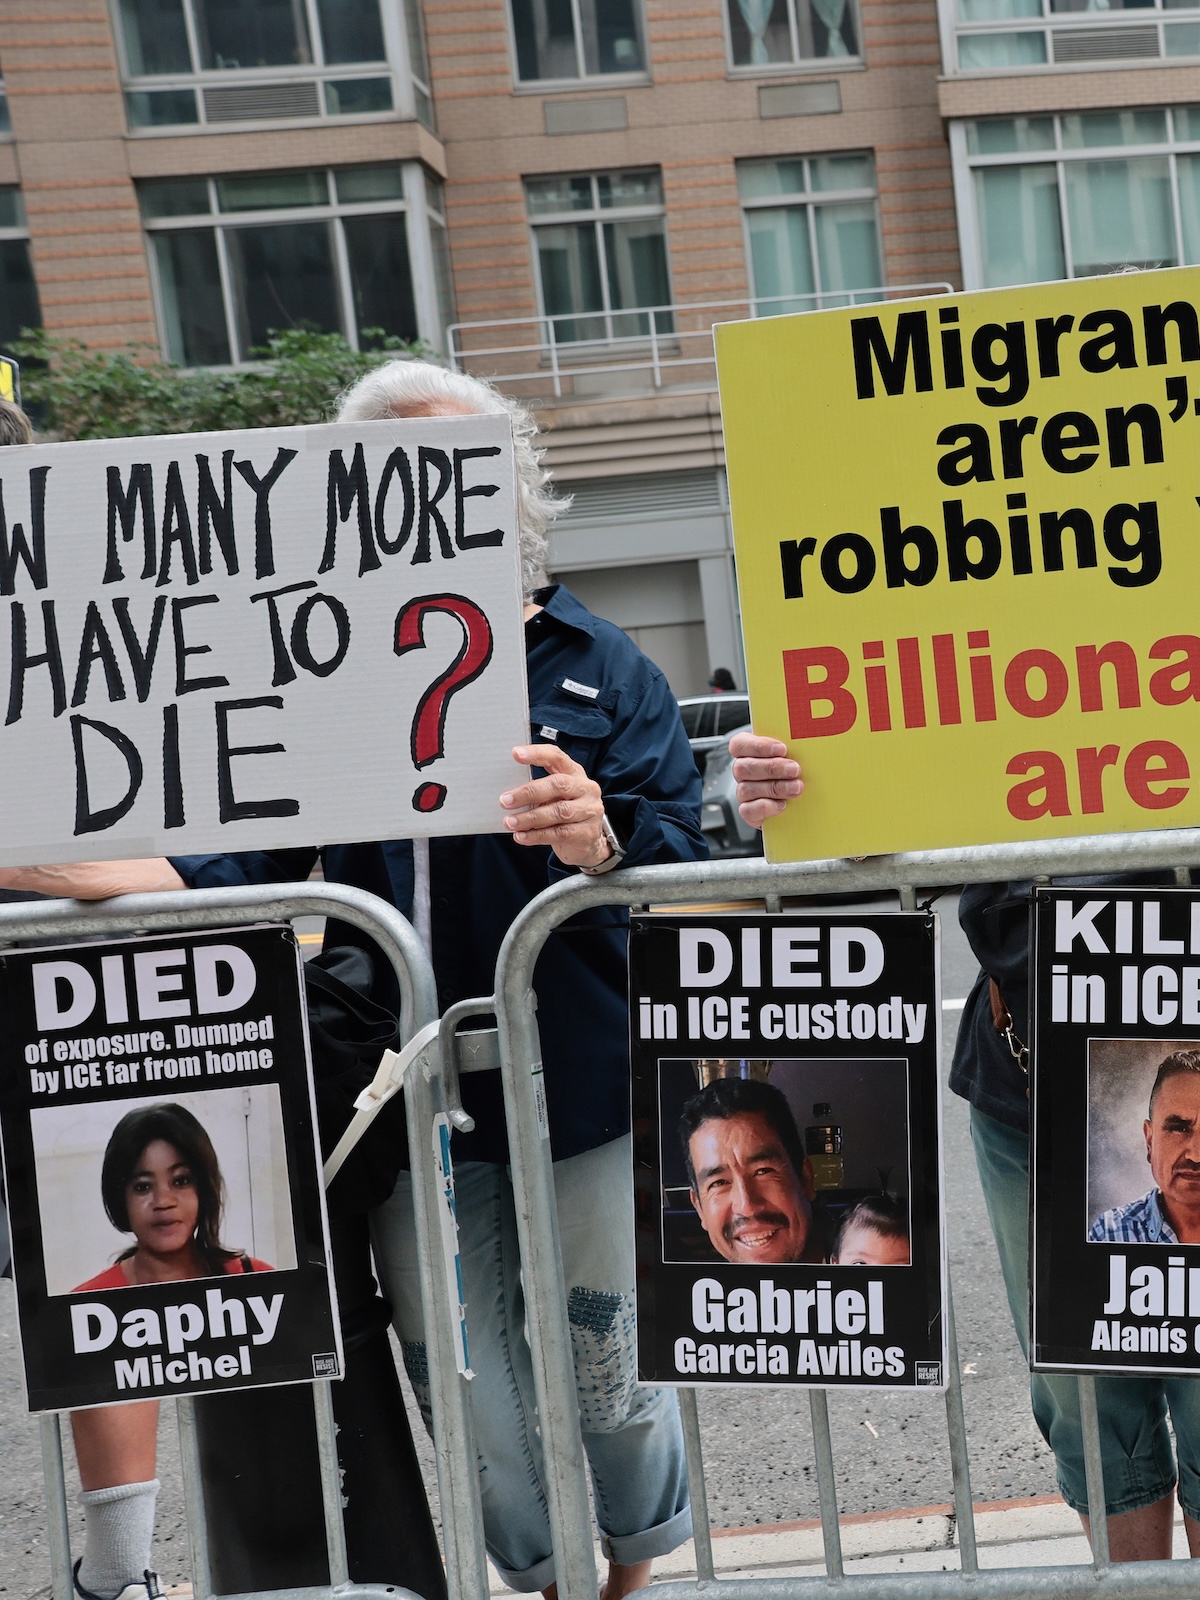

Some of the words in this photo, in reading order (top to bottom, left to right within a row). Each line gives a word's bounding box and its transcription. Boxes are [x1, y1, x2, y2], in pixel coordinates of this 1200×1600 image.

[103, 447, 298, 587] MANY
[318, 443, 503, 577] MORE
[780, 493, 1161, 599] robbing
[5, 595, 229, 725] HAVE
[250, 580, 350, 687] TO
[70, 696, 299, 835] DIE
[394, 593, 493, 812] ?
[680, 927, 884, 987] DIED
[32, 945, 256, 1031] DIED
[1052, 965, 1105, 1023] in
[25, 1039, 48, 1064] of
[54, 1031, 171, 1061] exposure.
[175, 1016, 274, 1048] Dumped
[640, 997, 677, 1039] in
[688, 996, 750, 1039] ICE
[760, 997, 927, 1043] custody
[30, 1069, 59, 1094] by
[64, 1062, 102, 1089] ICE
[105, 1061, 139, 1084] far
[144, 1056, 201, 1080] from
[205, 1049, 273, 1074] home
[71, 1289, 284, 1354] Daphy
[692, 1278, 884, 1334] Gabriel
[675, 1337, 789, 1374] Garcia
[797, 1340, 905, 1376] Aviles
[1091, 1320, 1187, 1353] Alanís
[115, 1346, 251, 1389] Michel
